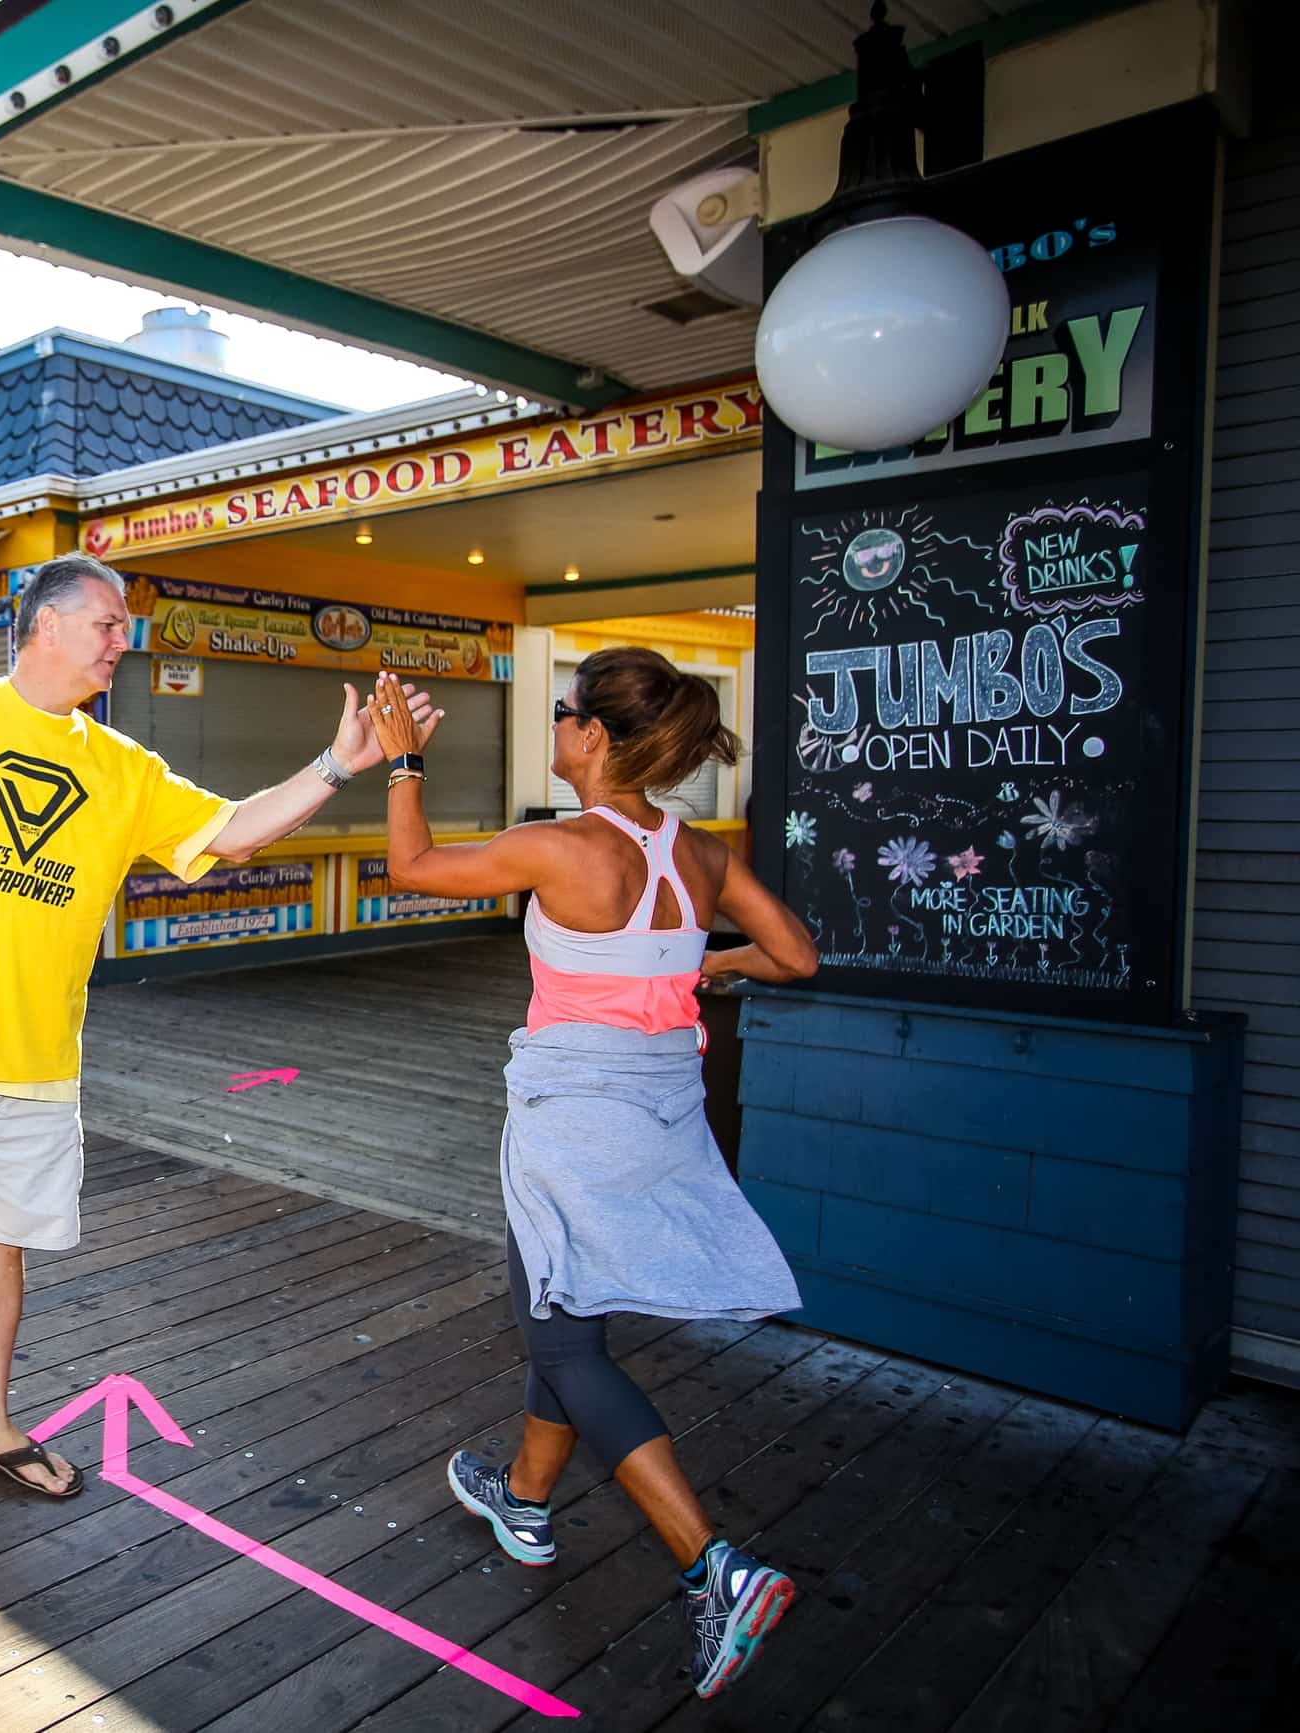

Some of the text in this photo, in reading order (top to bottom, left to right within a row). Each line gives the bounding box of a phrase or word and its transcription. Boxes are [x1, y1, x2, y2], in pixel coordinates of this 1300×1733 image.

[121, 390, 763, 546] Jumbo's SEAFOOD EATERY
[1025, 528, 1080, 561] NEW
[253, 592, 286, 609] Curley
[288, 596, 311, 611] Fries
[371, 609, 384, 620] Old
[211, 632, 297, 660] Shake-Ups
[381, 650, 452, 673] Shake-Ups
[806, 615, 1122, 734] JUMBO'S
[866, 722, 1080, 770] OPEN DAILY
[34, 857, 76, 883] YOUR
[238, 871, 275, 886] Curley
[279, 868, 305, 882] Fries
[368, 861, 383, 874] Old
[911, 887, 1089, 916] MORE SEATING
[177, 915, 269, 937] Established 1974
[943, 913, 1064, 939] IN GARDEN
